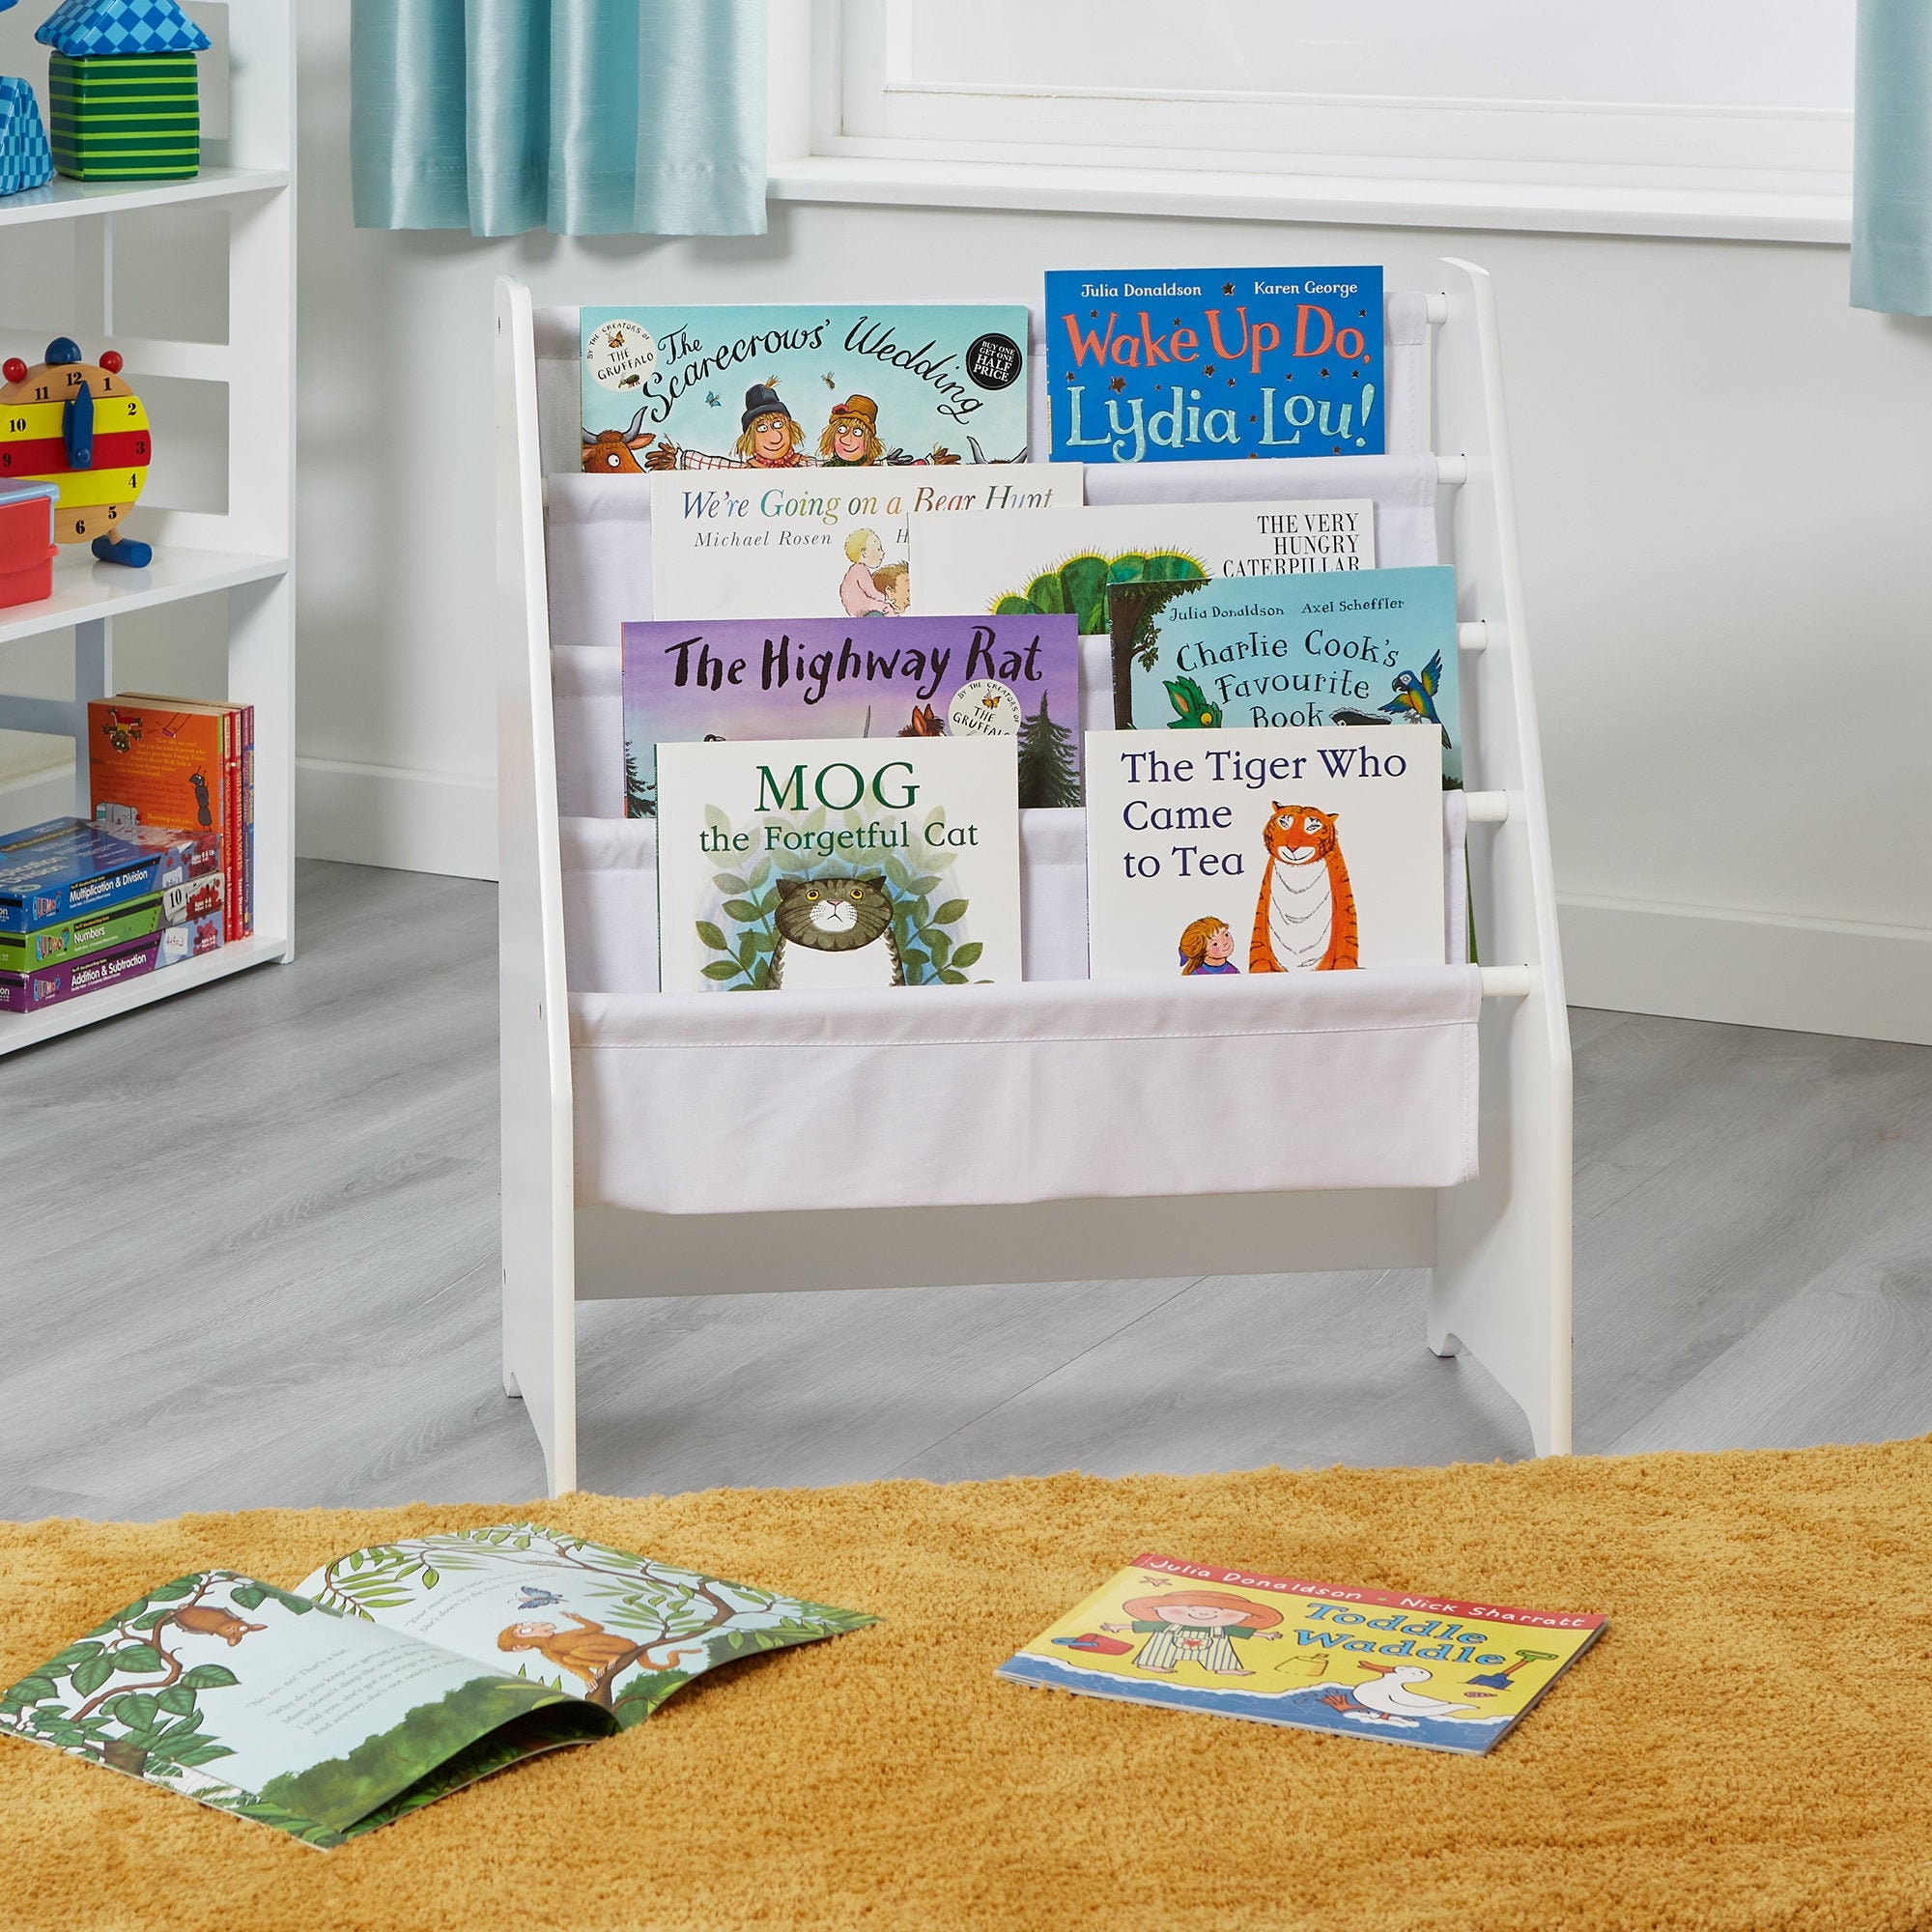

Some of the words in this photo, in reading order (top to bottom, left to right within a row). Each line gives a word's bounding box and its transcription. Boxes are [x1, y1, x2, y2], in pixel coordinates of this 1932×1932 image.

[1081, 283, 1119, 298] Julia
[1124, 282, 1202, 297] Donaldson
[1254, 282, 1300, 296] Karen
[1304, 280, 1358, 298] George
[602, 323, 642, 334] CREATORS
[589, 333, 600, 346] THE
[658, 324, 702, 365] The
[981, 341, 998, 351] BUY
[998, 346, 1015, 356] ONE
[1062, 311, 1200, 368] Wake
[1204, 306, 1281, 374] Up
[1293, 304, 1371, 365] Do,
[586, 349, 594, 359] BY
[608, 348, 630, 362] THE
[976, 354, 1012, 372] HALF
[979, 347, 996, 356] GET
[996, 353, 1014, 362] ONE
[597, 352, 654, 380] GRUFFALO
[844, 316, 983, 425] Wedding
[973, 363, 1009, 382] PRICE
[66, 372, 83, 386] 12
[102, 377, 112, 391] 1
[35, 386, 49, 401] 11
[128, 403, 137, 416] 2
[9, 418, 27, 433] 10
[1065, 385, 1241, 464] Lydia
[1259, 383, 1377, 449] Lou!
[136, 440, 146, 455] 3
[2, 453, 13, 467] 9
[128, 473, 137, 488] 4
[108, 505, 117, 520] 5
[682, 490, 749, 520] We're
[760, 488, 841, 526] Going
[847, 497, 879, 517] on
[886, 496, 903, 515] a
[913, 486, 977, 512] Bear
[984, 485, 1054, 509] Hunt
[75, 520, 86, 534] 6
[1257, 514, 1298, 534] THE
[1303, 513, 1359, 532] VERY
[694, 531, 770, 549] Michael
[778, 530, 833, 547] Rosen
[1273, 534, 1360, 555] HUNGRY
[1223, 556, 1360, 579] CATERPILLAR
[1169, 607, 1208, 623] Julia
[1211, 604, 1285, 619] Donaldson
[1301, 601, 1334, 615] Axel
[1338, 597, 1406, 612] Scheffler
[1177, 632, 1289, 672] Charlie
[1304, 629, 1400, 668] Cook's
[664, 637, 746, 692] The
[761, 635, 952, 705] Highway
[965, 625, 1044, 682] Rat
[1214, 668, 1370, 705] Favourite
[957, 690, 967, 699] BY
[968, 681, 981, 690] THE
[986, 682, 1019, 712] CREATORS
[1012, 714, 1020, 723] OF
[974, 705, 996, 723] THE
[1249, 702, 1324, 729] Book
[1121, 751, 1194, 783] The
[1205, 750, 1307, 789] Tiger
[1317, 745, 1407, 780] Who
[754, 761, 921, 813] MOG
[1122, 801, 1233, 832] Came
[699, 824, 750, 853] the
[764, 821, 910, 857] Forgetful
[923, 822, 980, 848] Cat
[1122, 851, 1161, 879] to
[1172, 845, 1245, 878] Tea
[70, 880, 114, 903] Multiplication
[115, 876, 122, 888] &
[122, 869, 148, 886] Division
[170, 889, 183, 909] 10
[73, 925, 105, 945] Numbers
[71, 969, 100, 987] Addition
[101, 966, 108, 977] &
[108, 953, 147, 975] Subtraction
[1150, 1556, 1211, 1579] Julia
[1222, 1572, 1363, 1603] Donaldson
[1400, 1596, 1457, 1616] Nick
[1466, 1605, 1587, 1630] Sharratt
[1305, 1602, 1490, 1647] Toddle
[1292, 1627, 1507, 1667] Waddle
